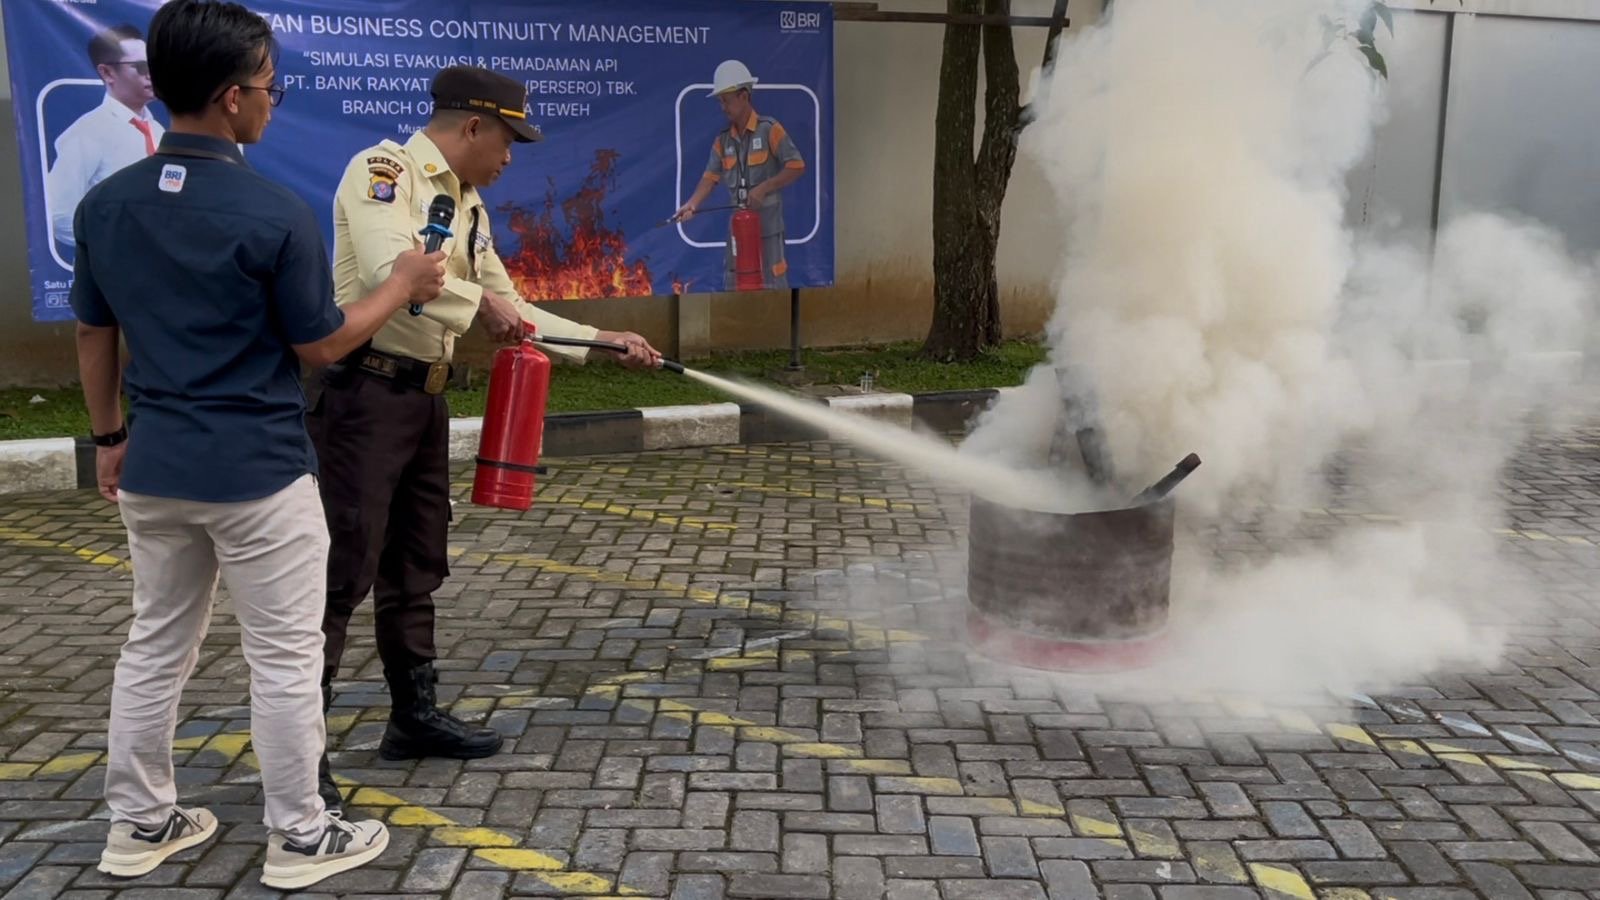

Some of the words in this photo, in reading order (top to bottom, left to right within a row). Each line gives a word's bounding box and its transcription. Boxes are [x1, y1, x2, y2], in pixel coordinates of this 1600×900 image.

[311, 15, 423, 38] BUSINESS
[430, 20, 562, 41] CONTINUITY
[569, 24, 711, 44] MANAGEMENT
[798, 13, 820, 28] BRI
[394, 53, 473, 69] EVAKUASI
[477, 56, 487, 69] &
[491, 56, 591, 72] PEMADAMAN
[595, 58, 618, 72] API
[284, 75, 310, 90] PT.
[315, 75, 362, 91] BANK
[367, 77, 430, 92] RAKYAT
[525, 80, 601, 96] (PERSERO)
[606, 81, 637, 95] TBK.
[342, 100, 412, 115] BRANCH
[538, 102, 590, 117] TEWEH
[44, 280, 67, 289] Satu
